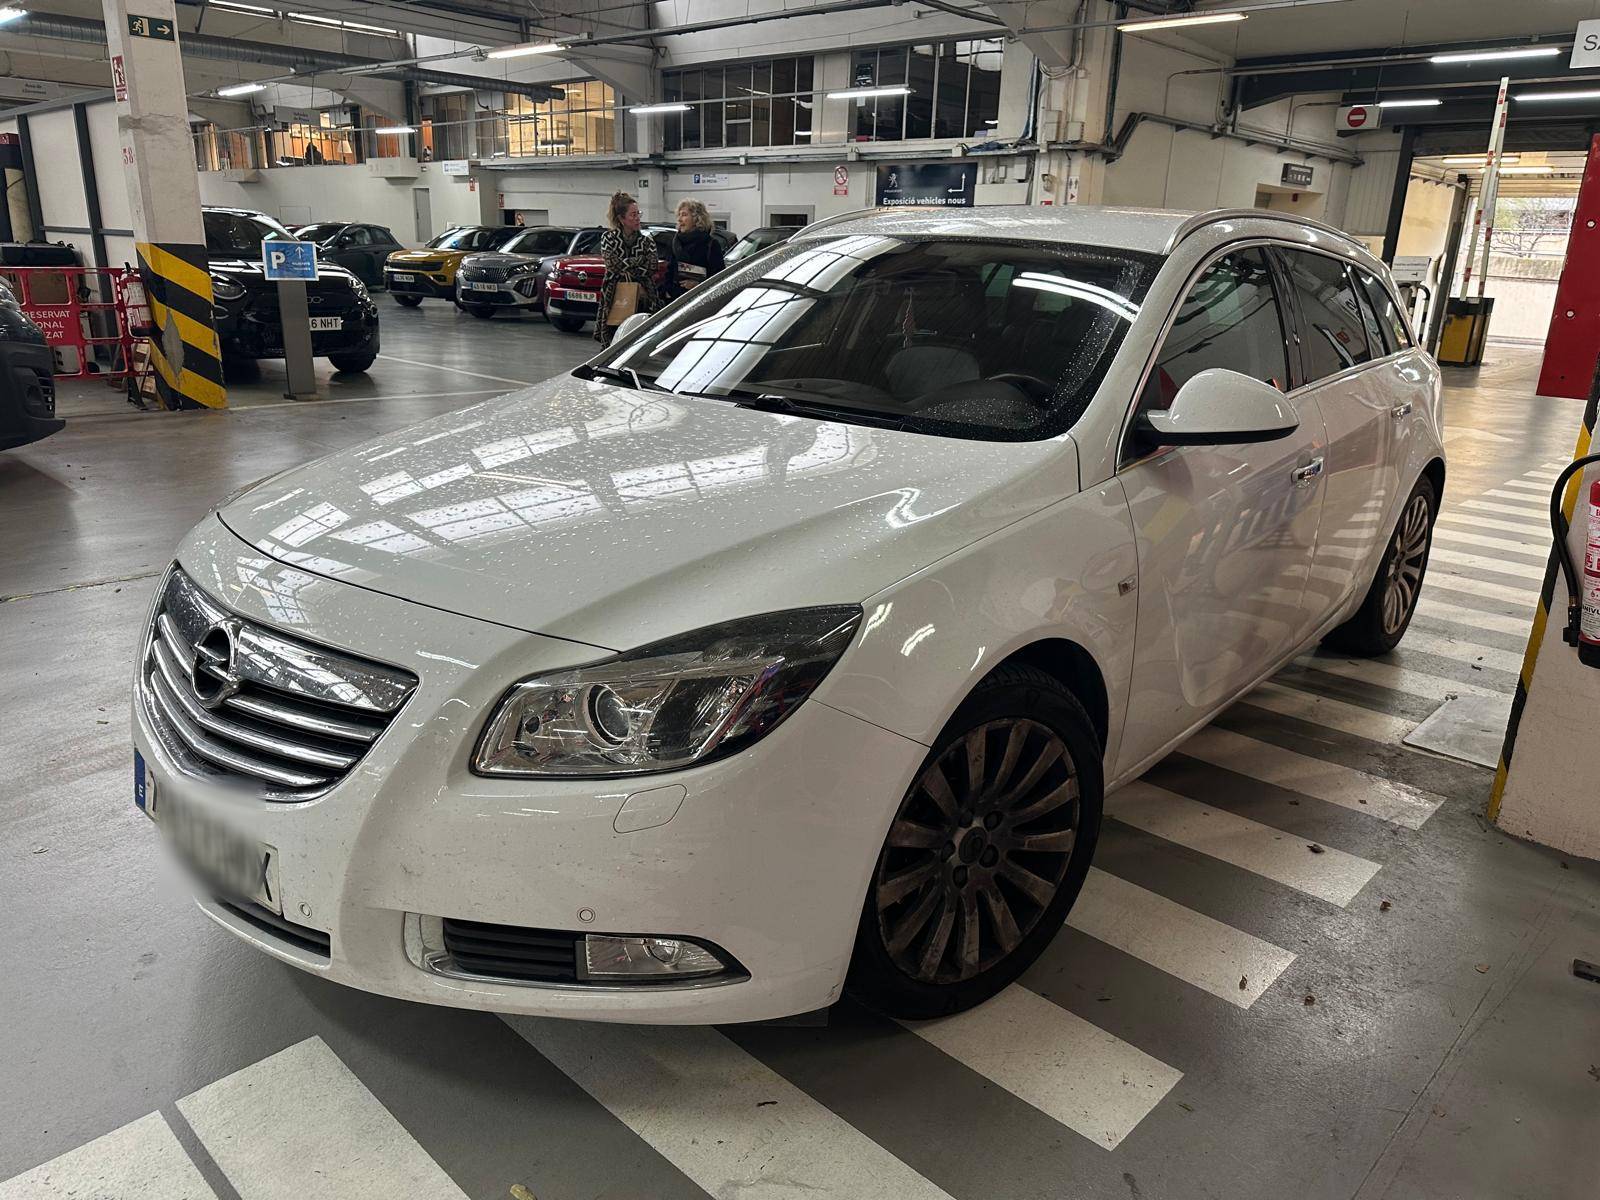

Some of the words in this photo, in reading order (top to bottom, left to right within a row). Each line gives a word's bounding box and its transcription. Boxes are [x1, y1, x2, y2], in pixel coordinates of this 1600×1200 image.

[1583, 34, 1600, 51] S
[882, 197, 915, 206] Exposició
[916, 197, 946, 205] vehicles
[947, 197, 967, 205] nous
[271, 251, 286, 270] P
[320, 318, 339, 328] NHT
